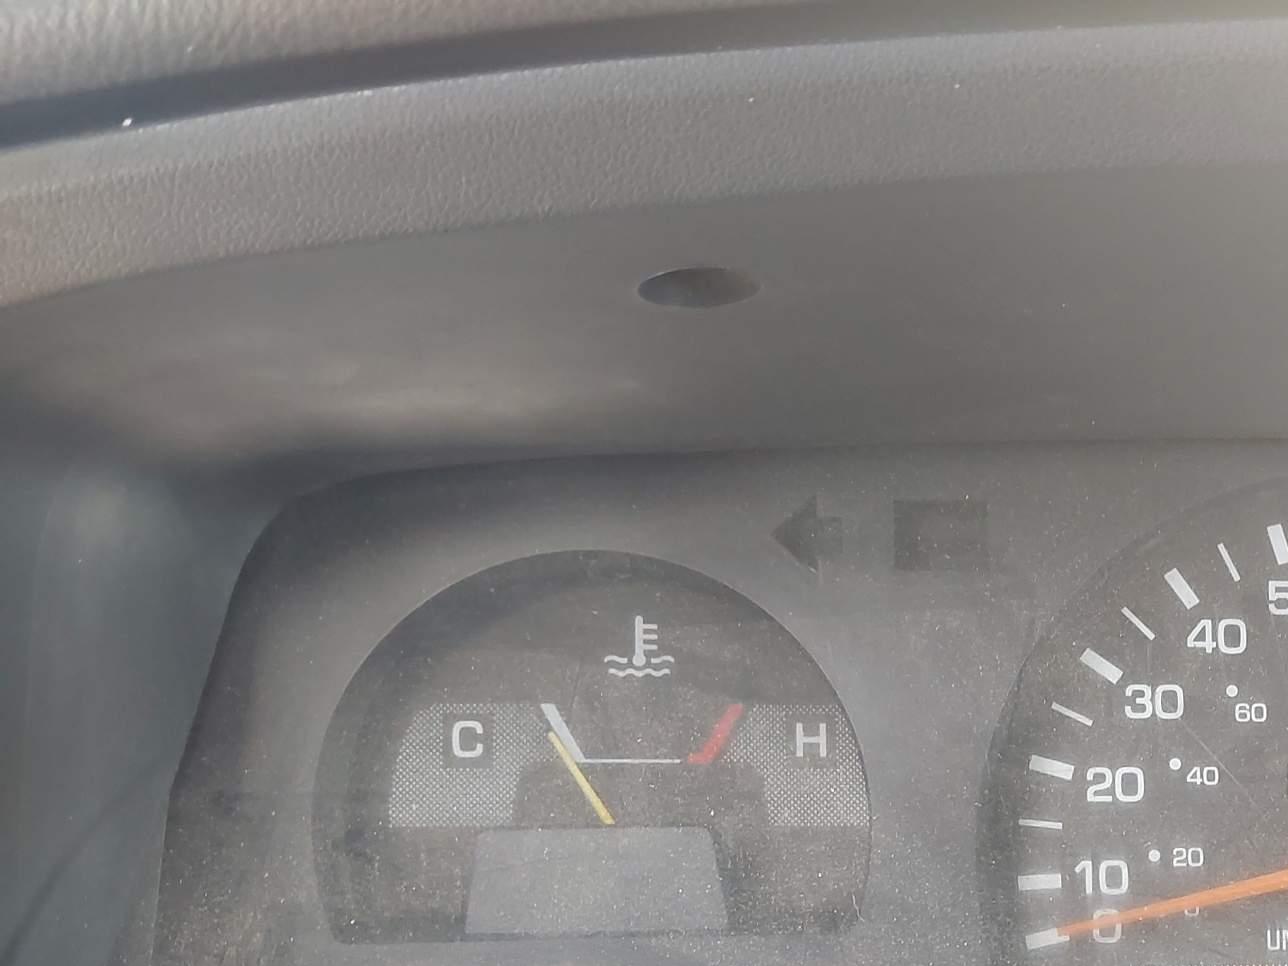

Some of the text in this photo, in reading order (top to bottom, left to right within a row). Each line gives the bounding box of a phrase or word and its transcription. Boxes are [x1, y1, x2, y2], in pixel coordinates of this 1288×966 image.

[1186, 618, 1247, 654] 40
[1124, 684, 1184, 720] 30
[1234, 703, 1267, 722] 60
[451, 720, 484, 759] C
[795, 722, 828, 758] H
[1086, 766, 1145, 803] 20
[1186, 766, 1219, 786] 40
[1172, 847, 1204, 867] 20
[1074, 859, 1129, 896] 10
[1092, 908, 1122, 944] 0
